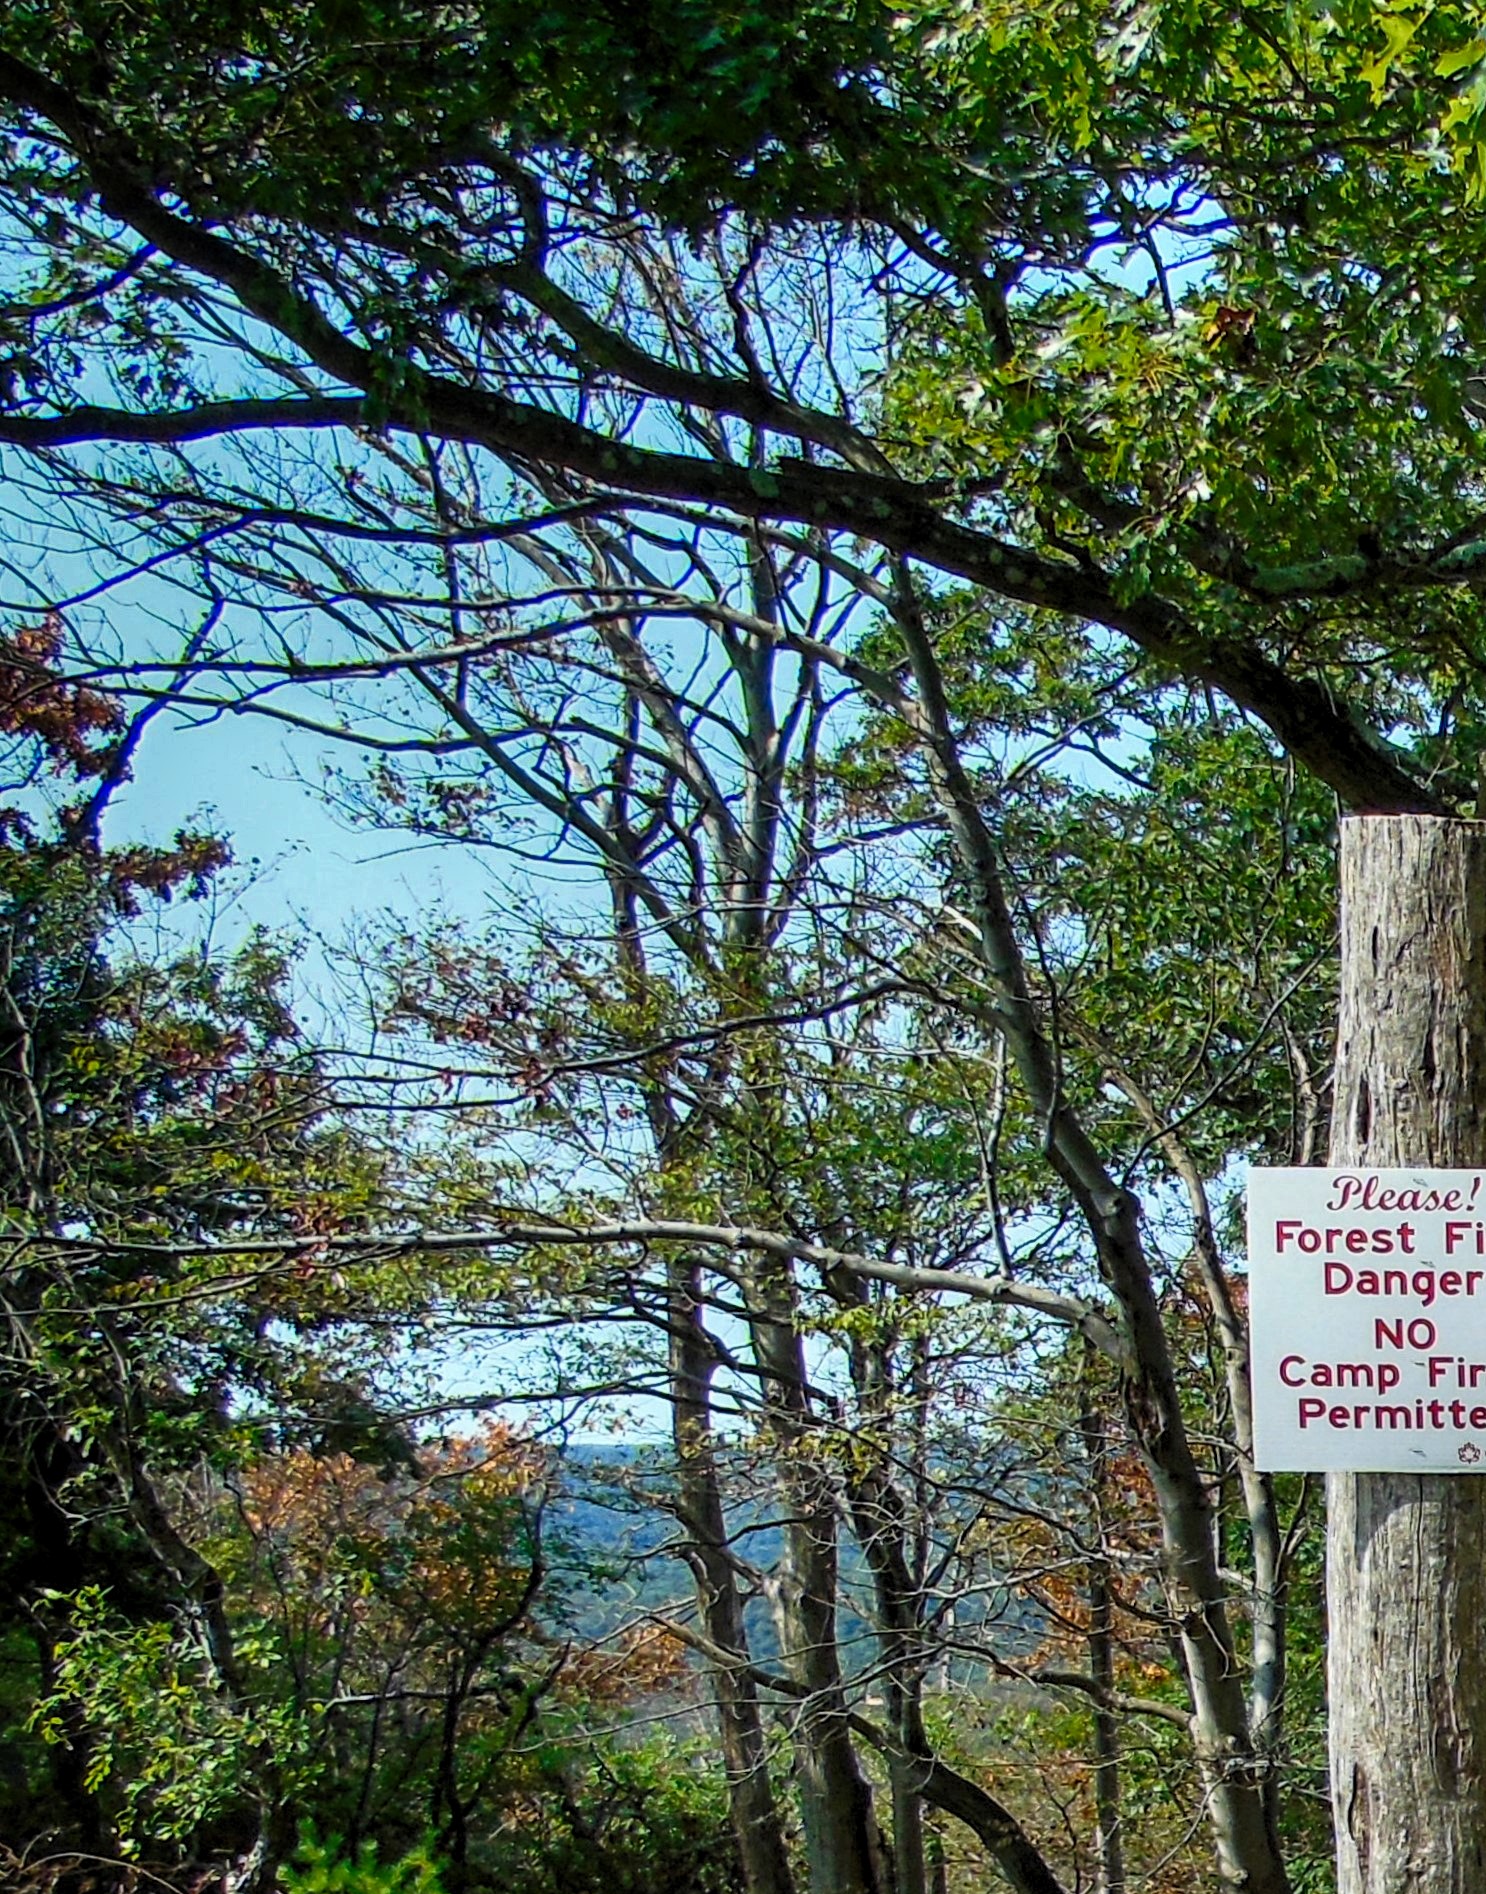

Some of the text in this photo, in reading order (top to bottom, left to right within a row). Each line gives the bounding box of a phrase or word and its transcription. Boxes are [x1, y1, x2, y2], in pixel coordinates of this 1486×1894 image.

[1326, 1175, 1483, 1212] Please!
[1275, 1220, 1416, 1254] Forest
[1324, 1262, 1484, 1307] Danger
[1374, 1317, 1437, 1350] NO
[1278, 1355, 1401, 1396] Camp
